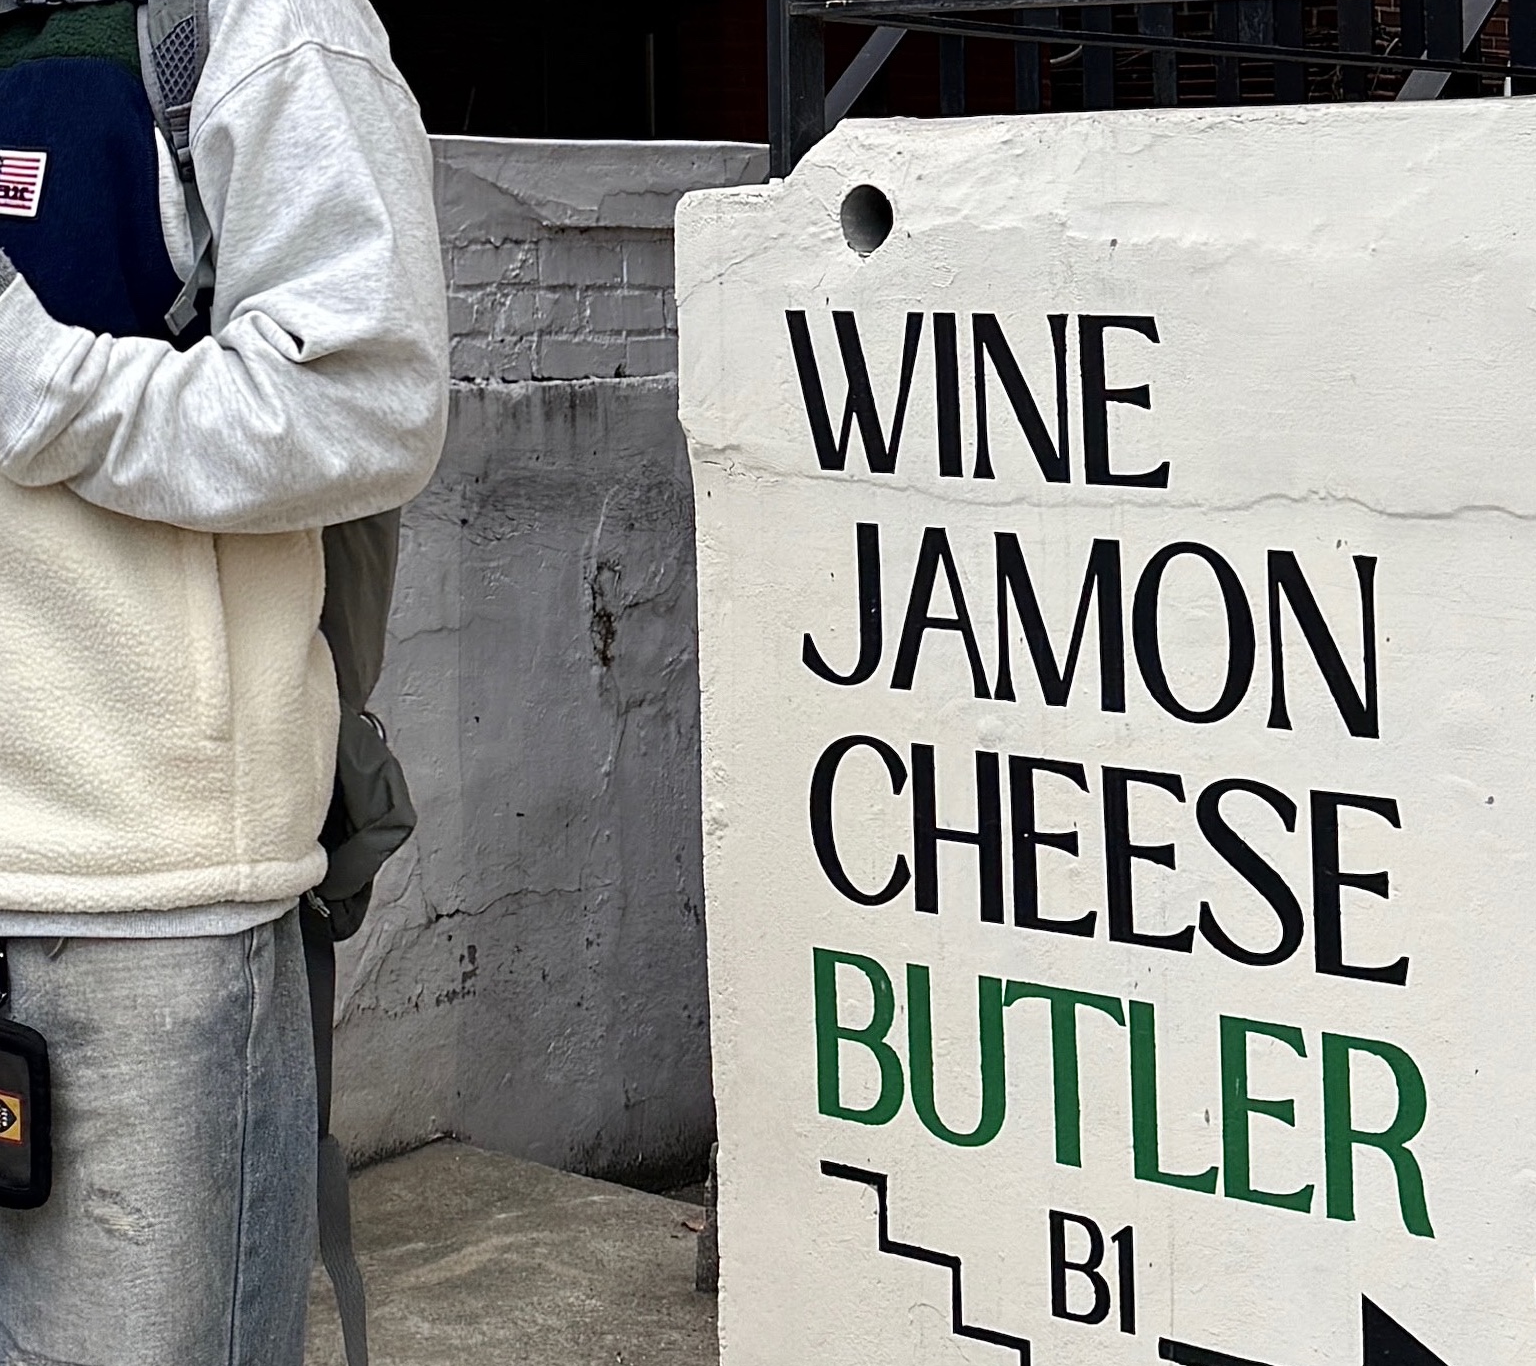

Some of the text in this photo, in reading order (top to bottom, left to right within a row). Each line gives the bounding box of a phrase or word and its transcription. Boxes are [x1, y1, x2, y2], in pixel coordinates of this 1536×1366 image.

[784, 309, 1171, 489] WINE
[801, 521, 1379, 740] JAMON
[809, 734, 1411, 987] CHEESE
[811, 946, 1436, 1240] BUTLER
[1048, 1208, 1137, 1337] B1
